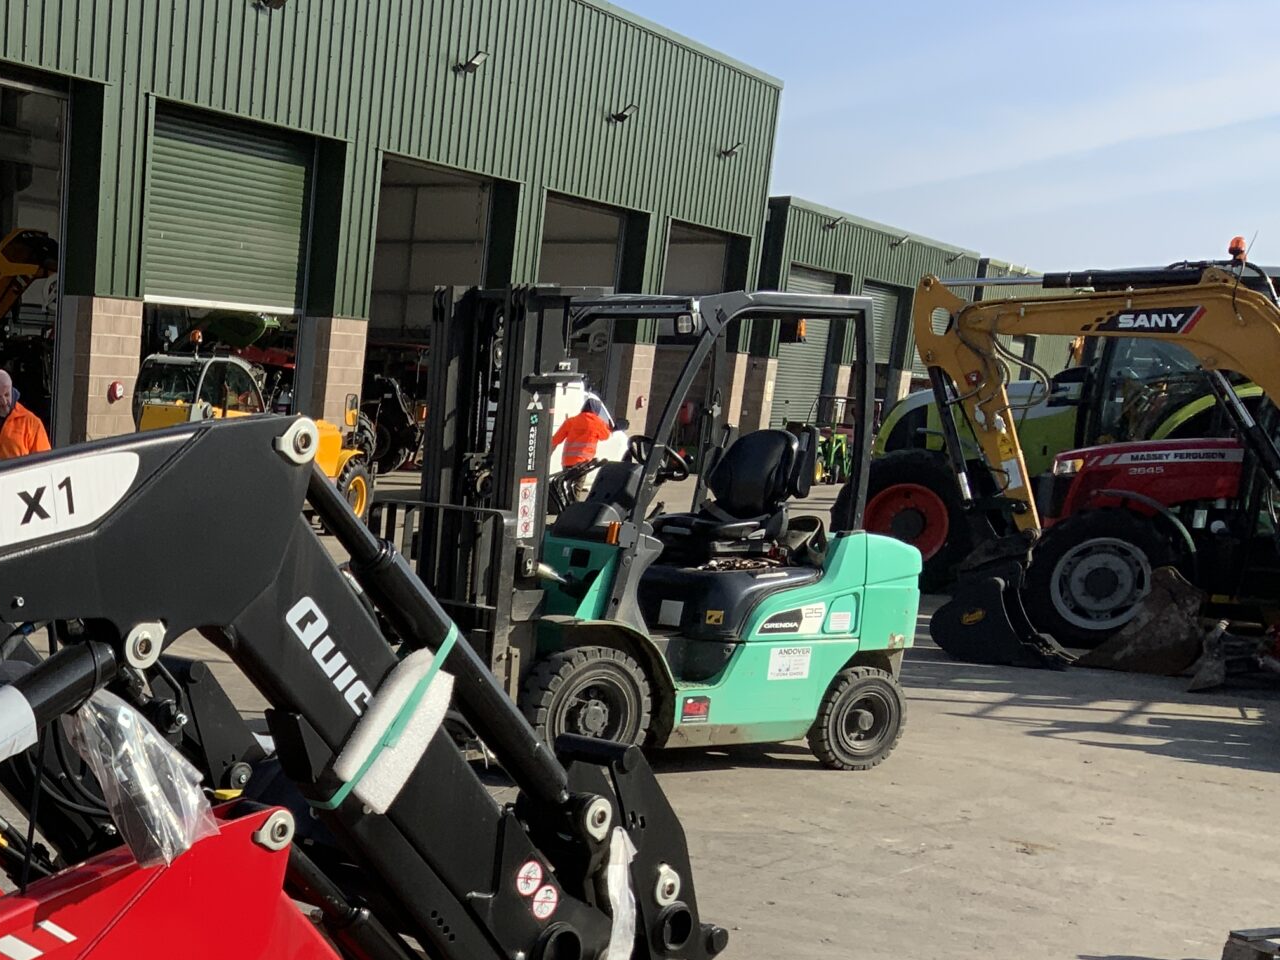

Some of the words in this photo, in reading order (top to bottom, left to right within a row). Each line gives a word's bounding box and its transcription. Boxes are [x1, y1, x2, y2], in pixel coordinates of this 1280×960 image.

[1118, 313, 1185, 328] SANY
[1130, 453, 1171, 461] MASSEY
[1174, 452, 1226, 460] FERGUSON
[804, 607, 824, 619] 25
[778, 647, 811, 656] ANDOVER
